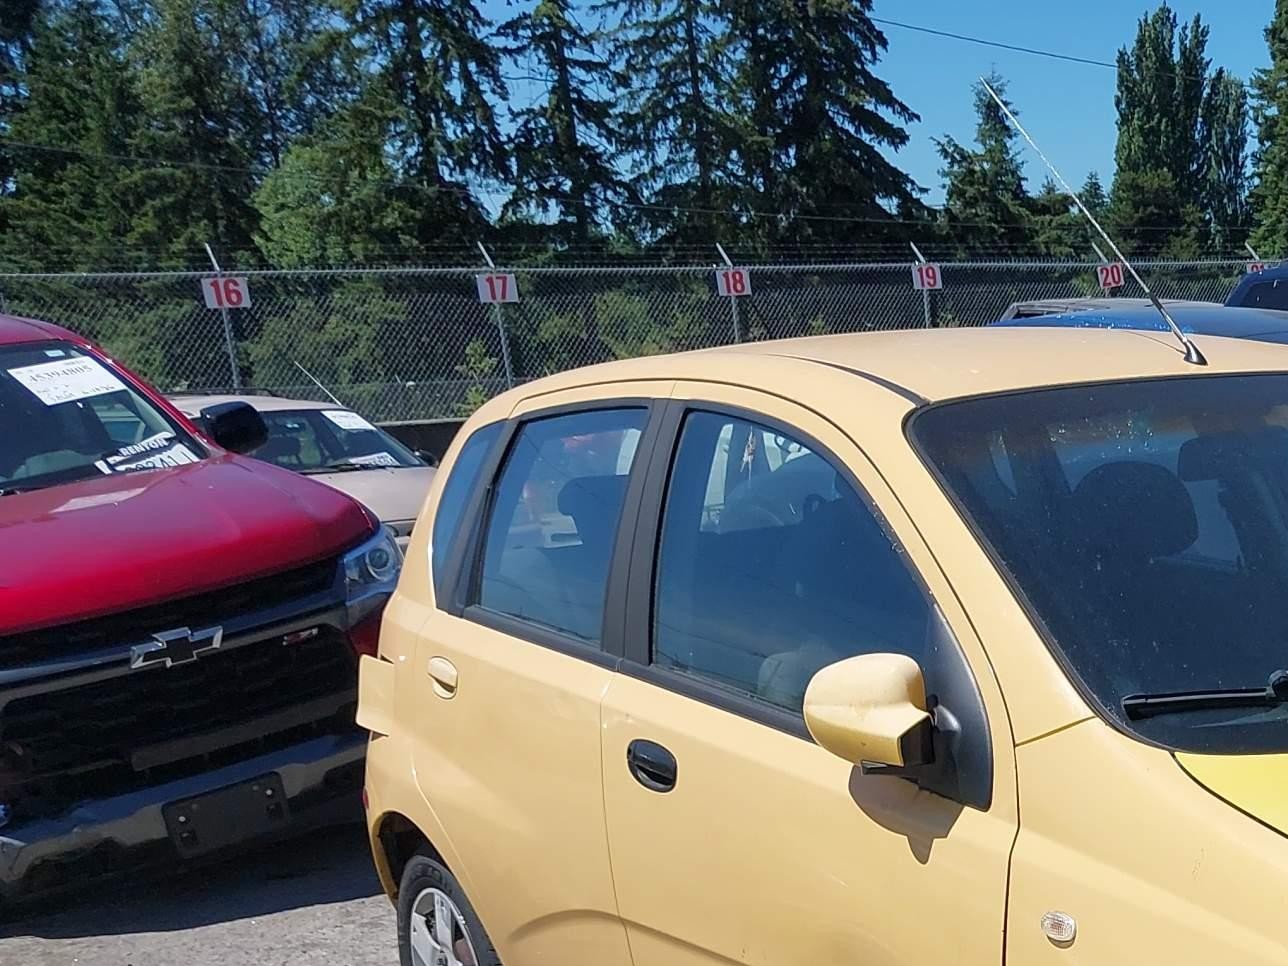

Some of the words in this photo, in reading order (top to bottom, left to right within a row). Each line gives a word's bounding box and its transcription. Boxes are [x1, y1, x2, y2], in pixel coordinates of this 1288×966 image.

[724, 272, 748, 295] 18
[918, 266, 942, 288] 19
[1101, 266, 1122, 288] 20
[210, 279, 242, 306] 16
[485, 276, 508, 301] 17
[118, 437, 170, 456] RENTON
